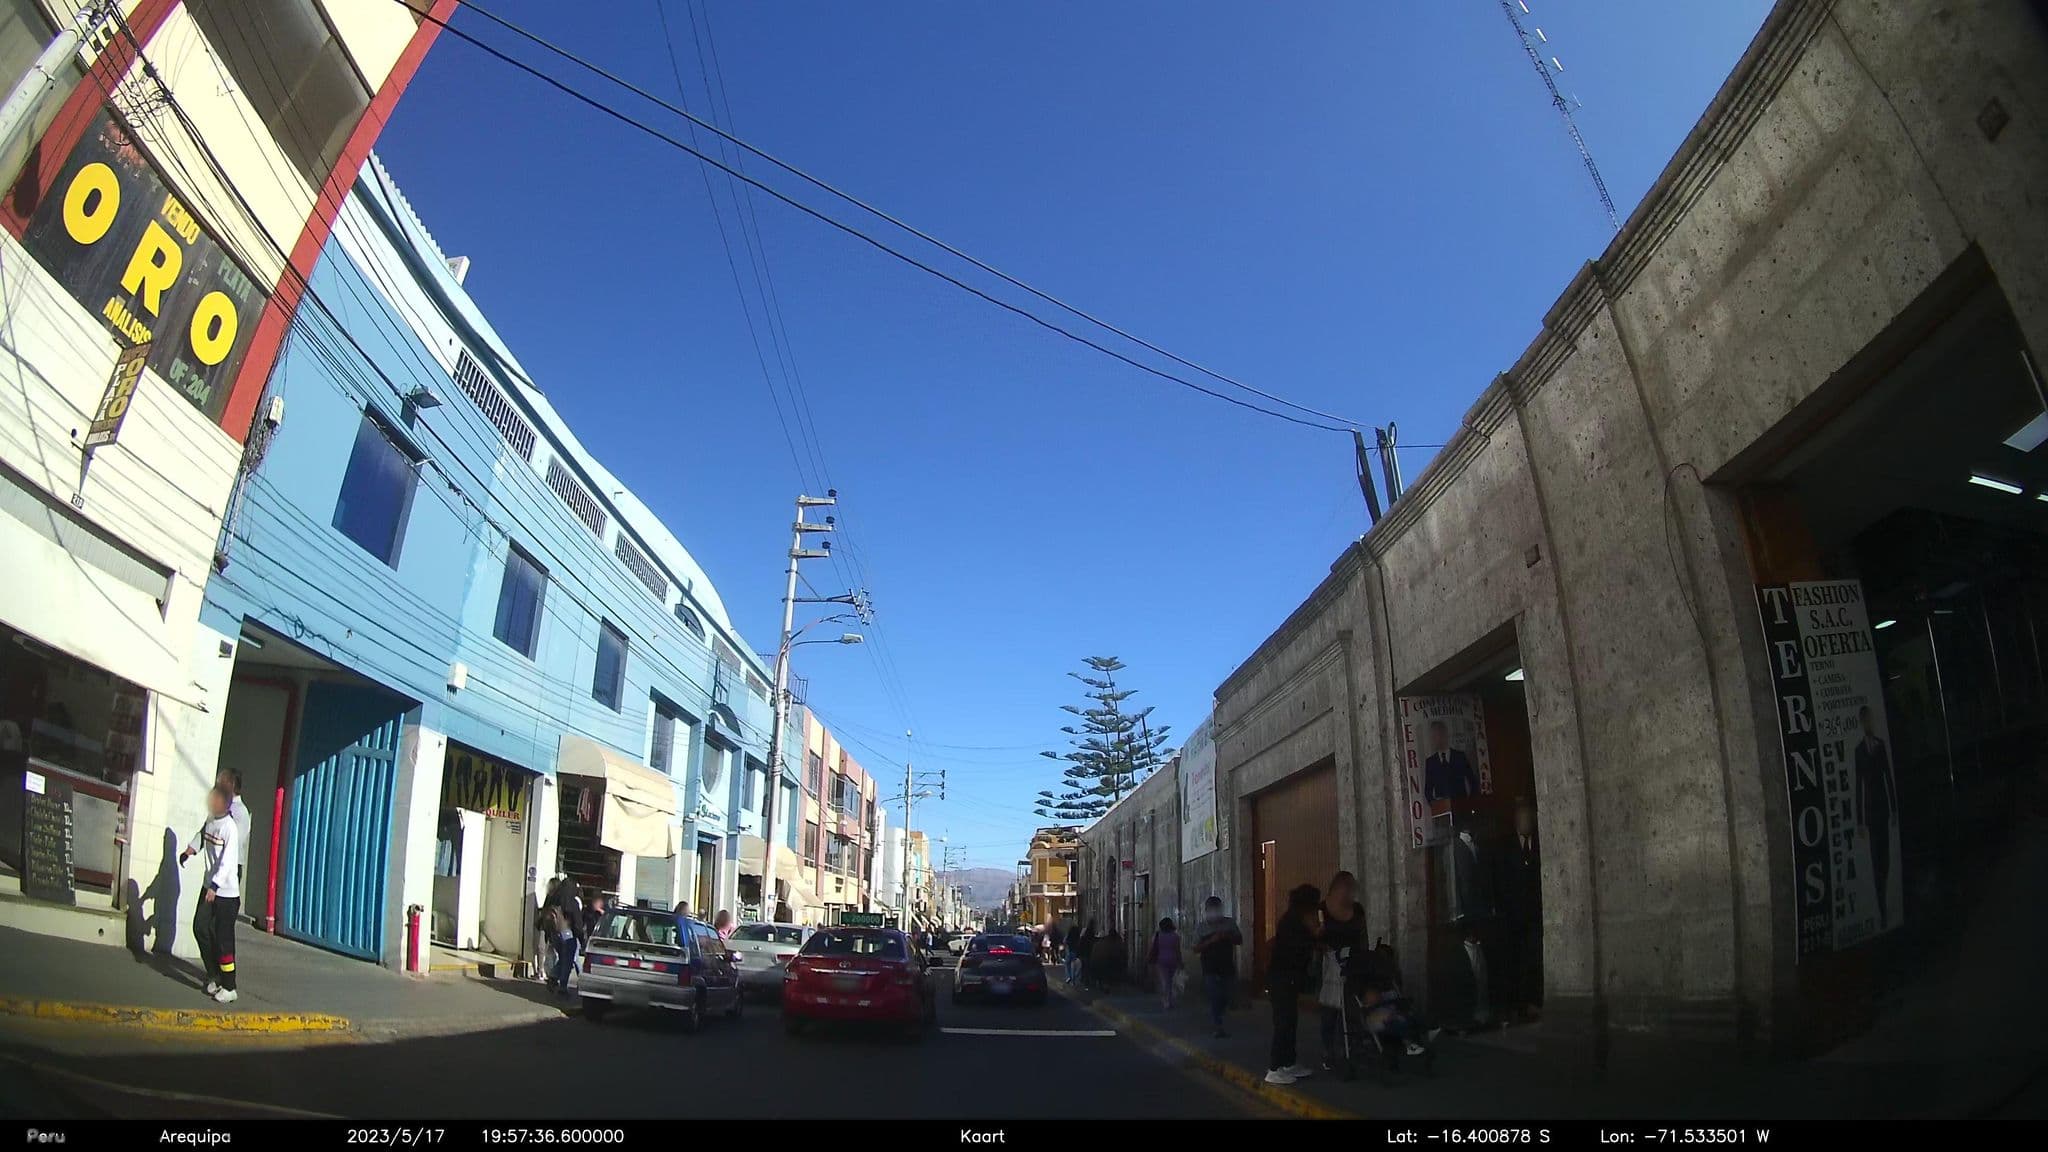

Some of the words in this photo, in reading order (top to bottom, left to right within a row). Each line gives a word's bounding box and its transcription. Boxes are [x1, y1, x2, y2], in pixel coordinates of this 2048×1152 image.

[161, 193, 200, 245] VENDO
[63, 162, 238, 366] ORO
[108, 357, 146, 418] ORO
[1791, 585, 1861, 607] FASHION
[1809, 607, 1854, 630] S.A.C.
[1804, 630, 1874, 659] OFERTA
[1400, 698, 1424, 847] TERNOS
[1762, 586, 1827, 905] TERNOS
